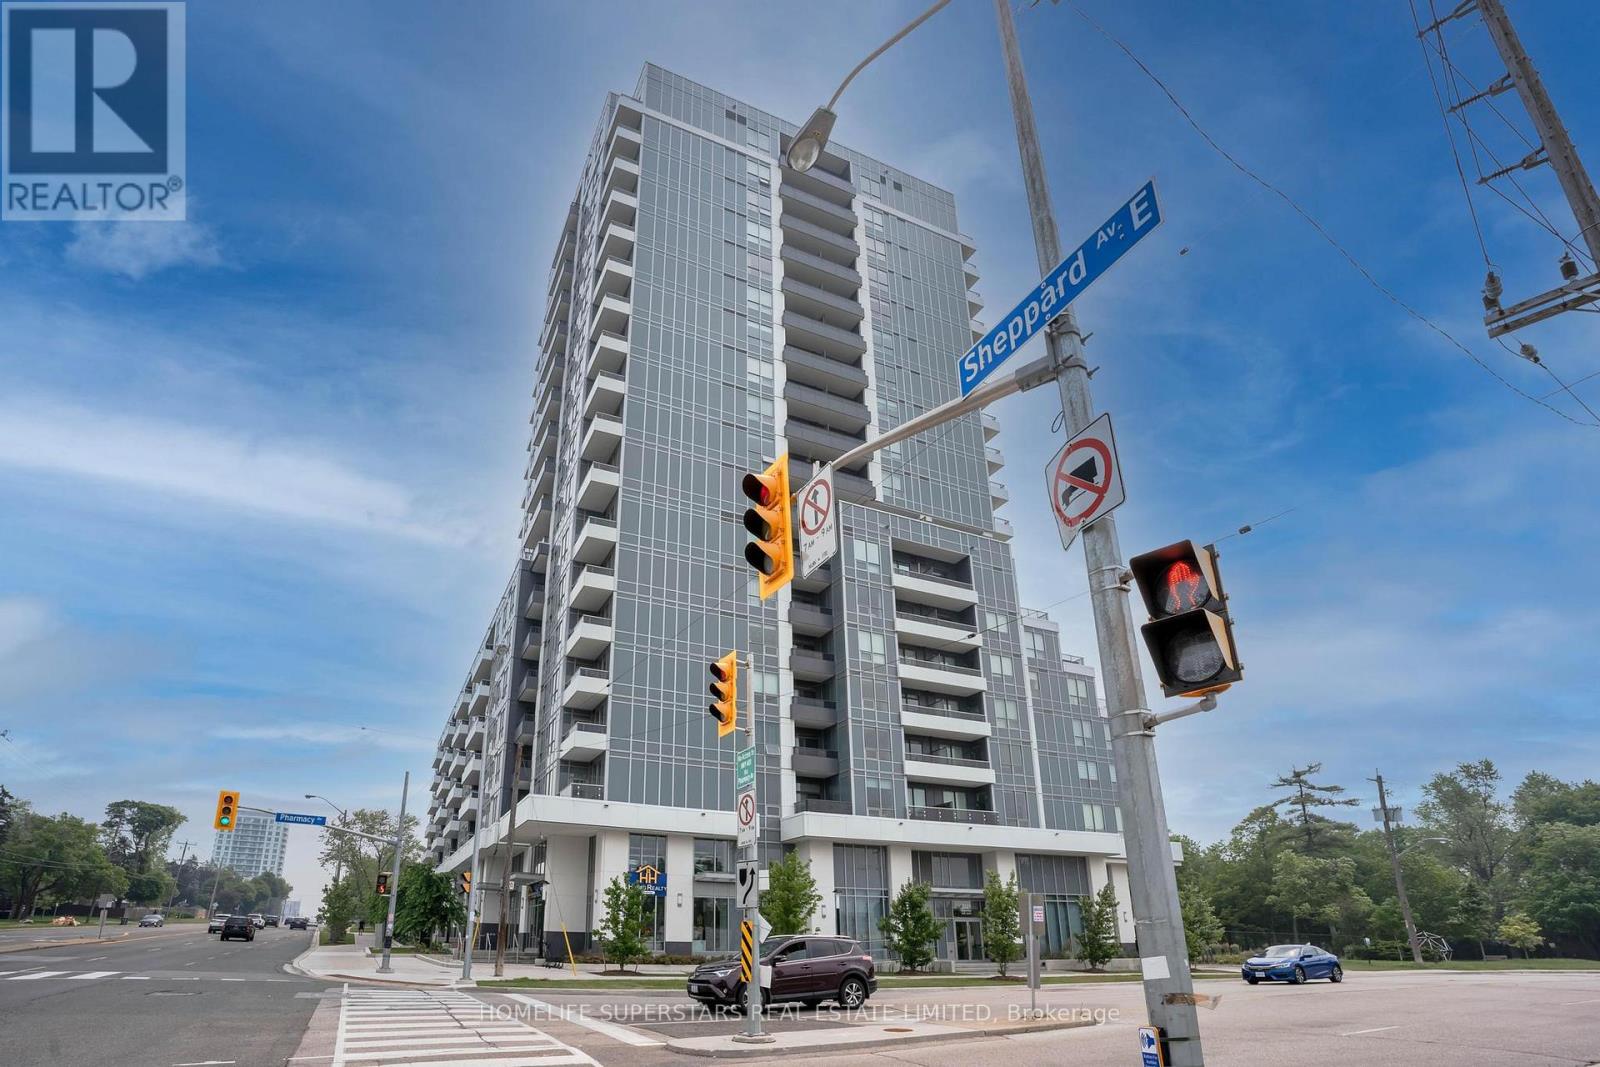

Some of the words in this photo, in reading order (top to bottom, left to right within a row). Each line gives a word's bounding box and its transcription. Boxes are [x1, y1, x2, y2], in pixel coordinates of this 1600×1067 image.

[964, 249, 1087, 382] Sheppard
[1130, 190, 1152, 231] E
[279, 813, 315, 825] Pharmacy
